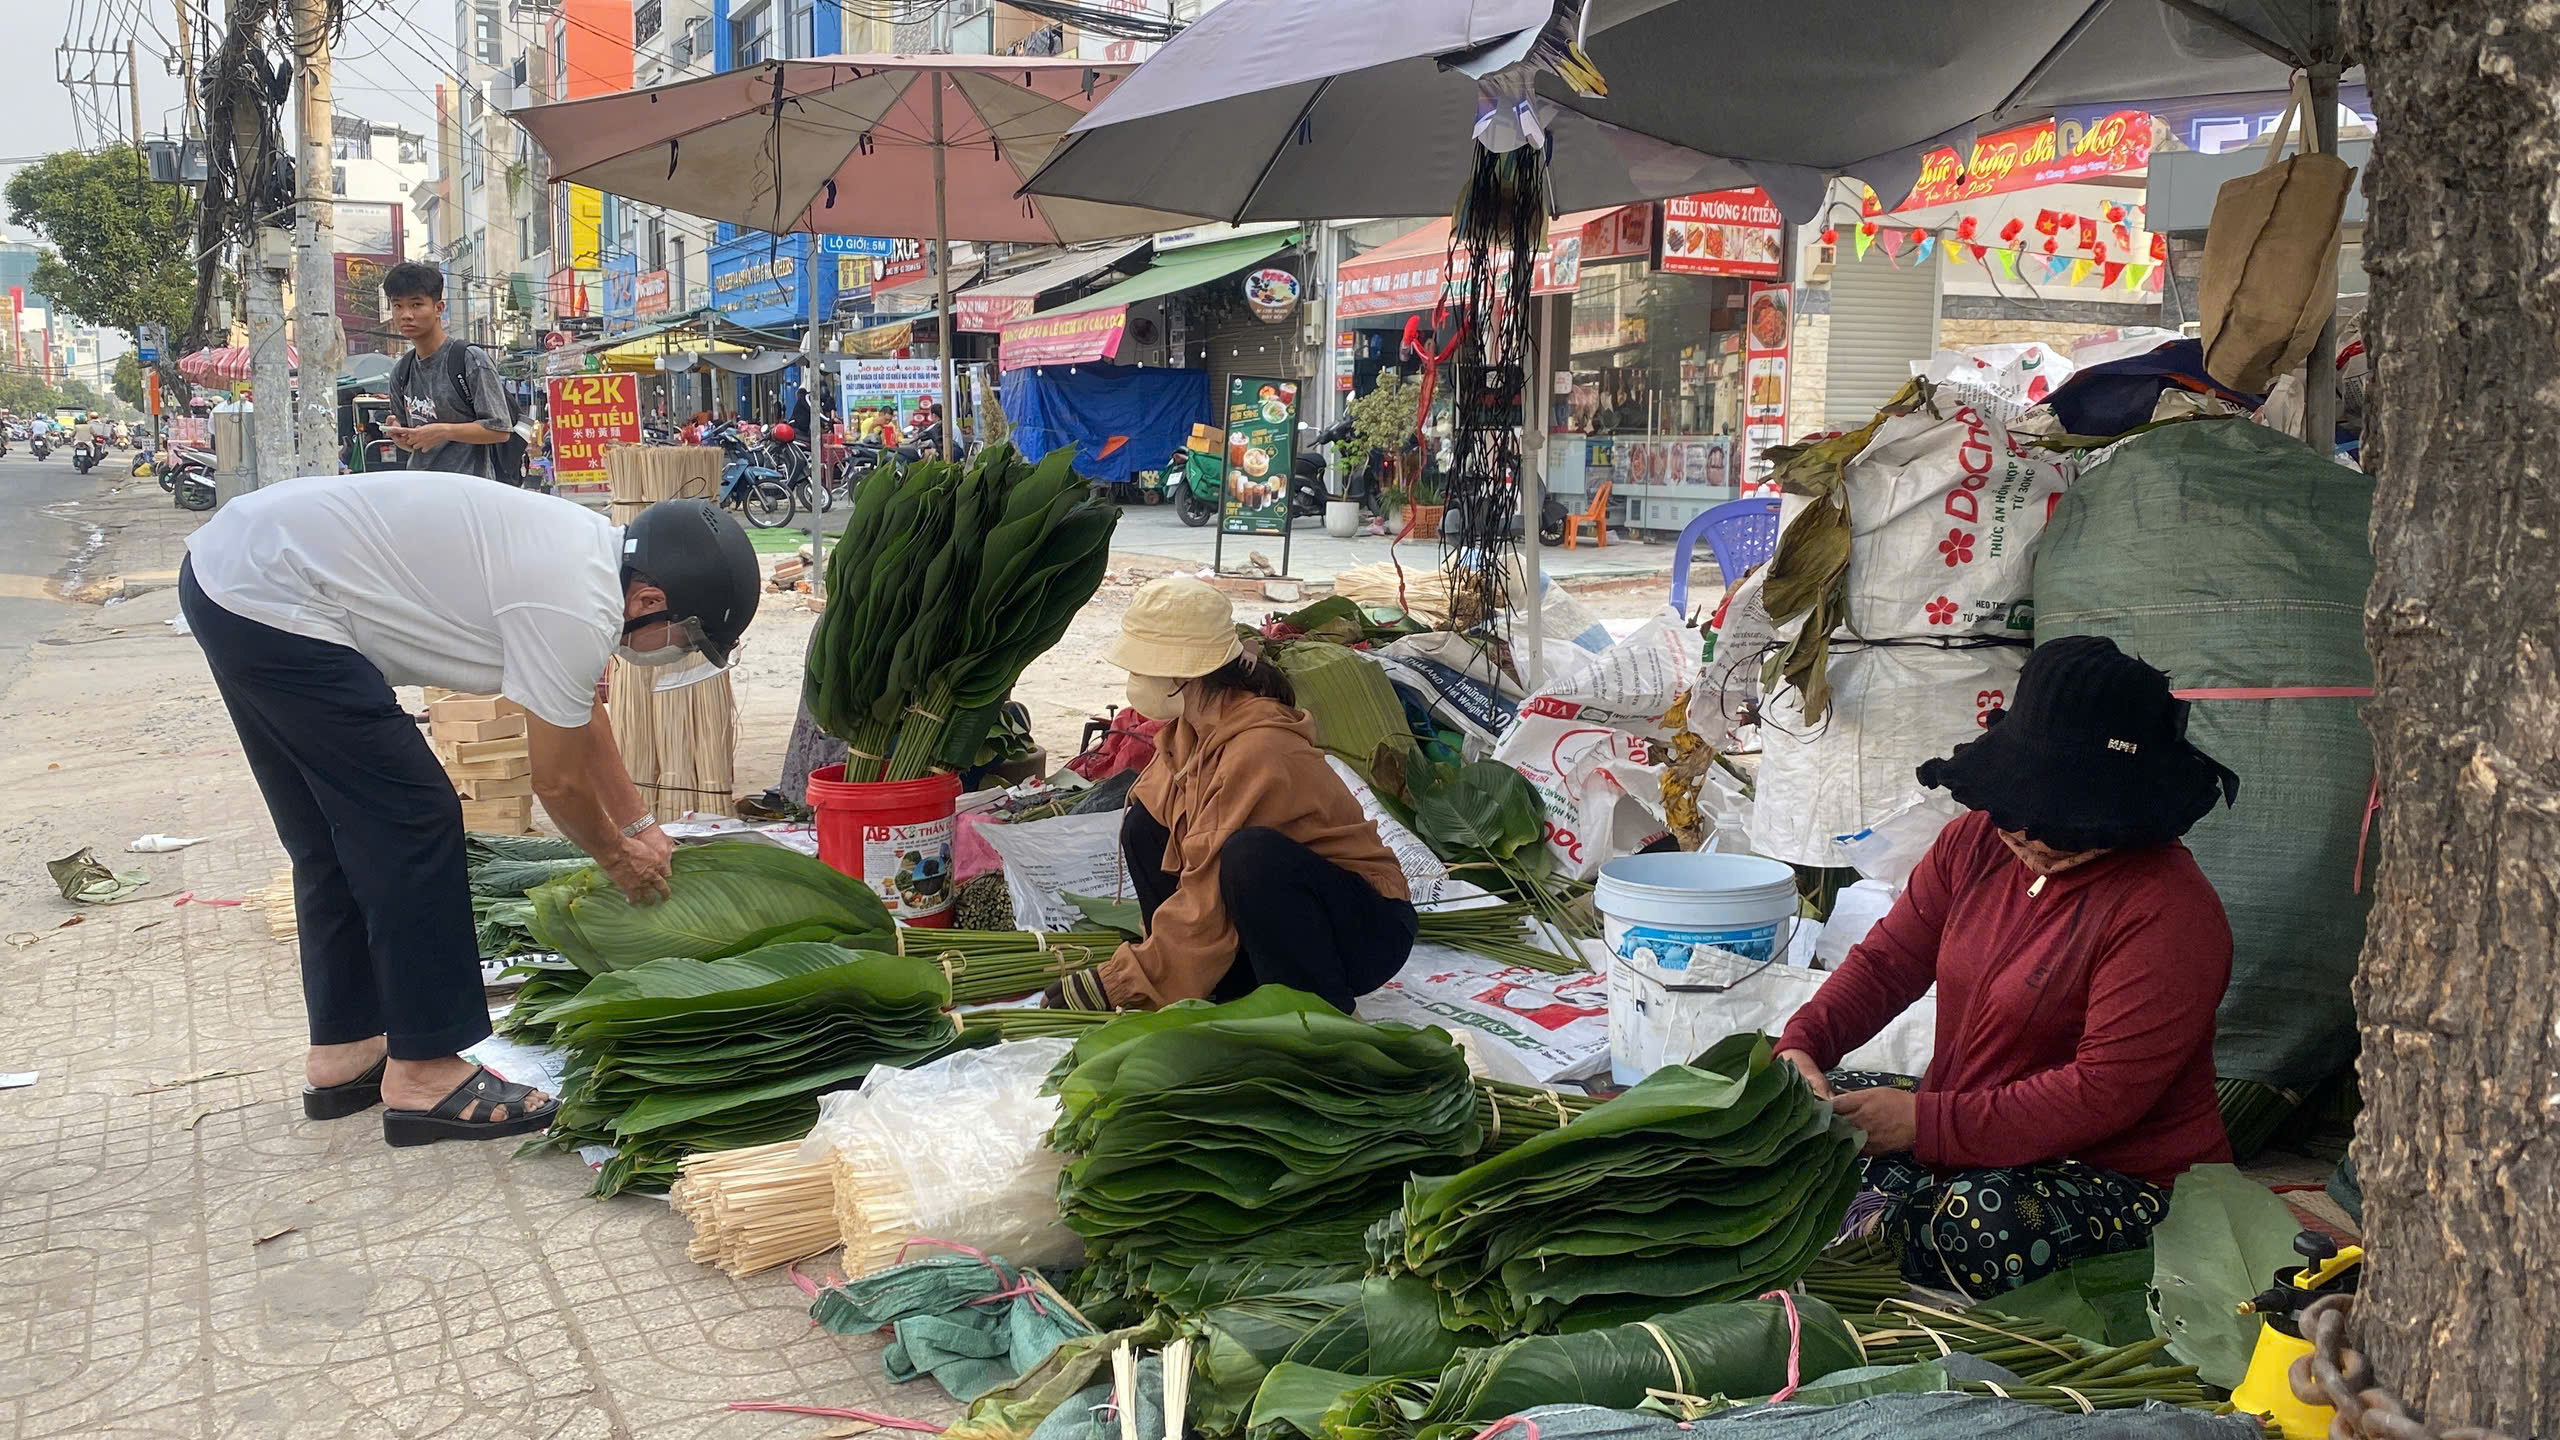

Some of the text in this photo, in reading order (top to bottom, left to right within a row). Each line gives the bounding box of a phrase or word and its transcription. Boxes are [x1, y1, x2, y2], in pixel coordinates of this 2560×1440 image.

[1700, 201, 1740, 221] NƯƠNG
[872, 241, 886, 251] 5M
[562, 376, 624, 405] 42K
[556, 406, 634, 428] HỦ TIẾU
[560, 440, 592, 458] SỦI
[2012, 468, 2035, 511] TỪ 30KG
[1990, 527, 2004, 559] THỨC
[1997, 507, 2006, 525] ĂN
[1458, 696, 1484, 719] Weight
[865, 826, 891, 841] AB
